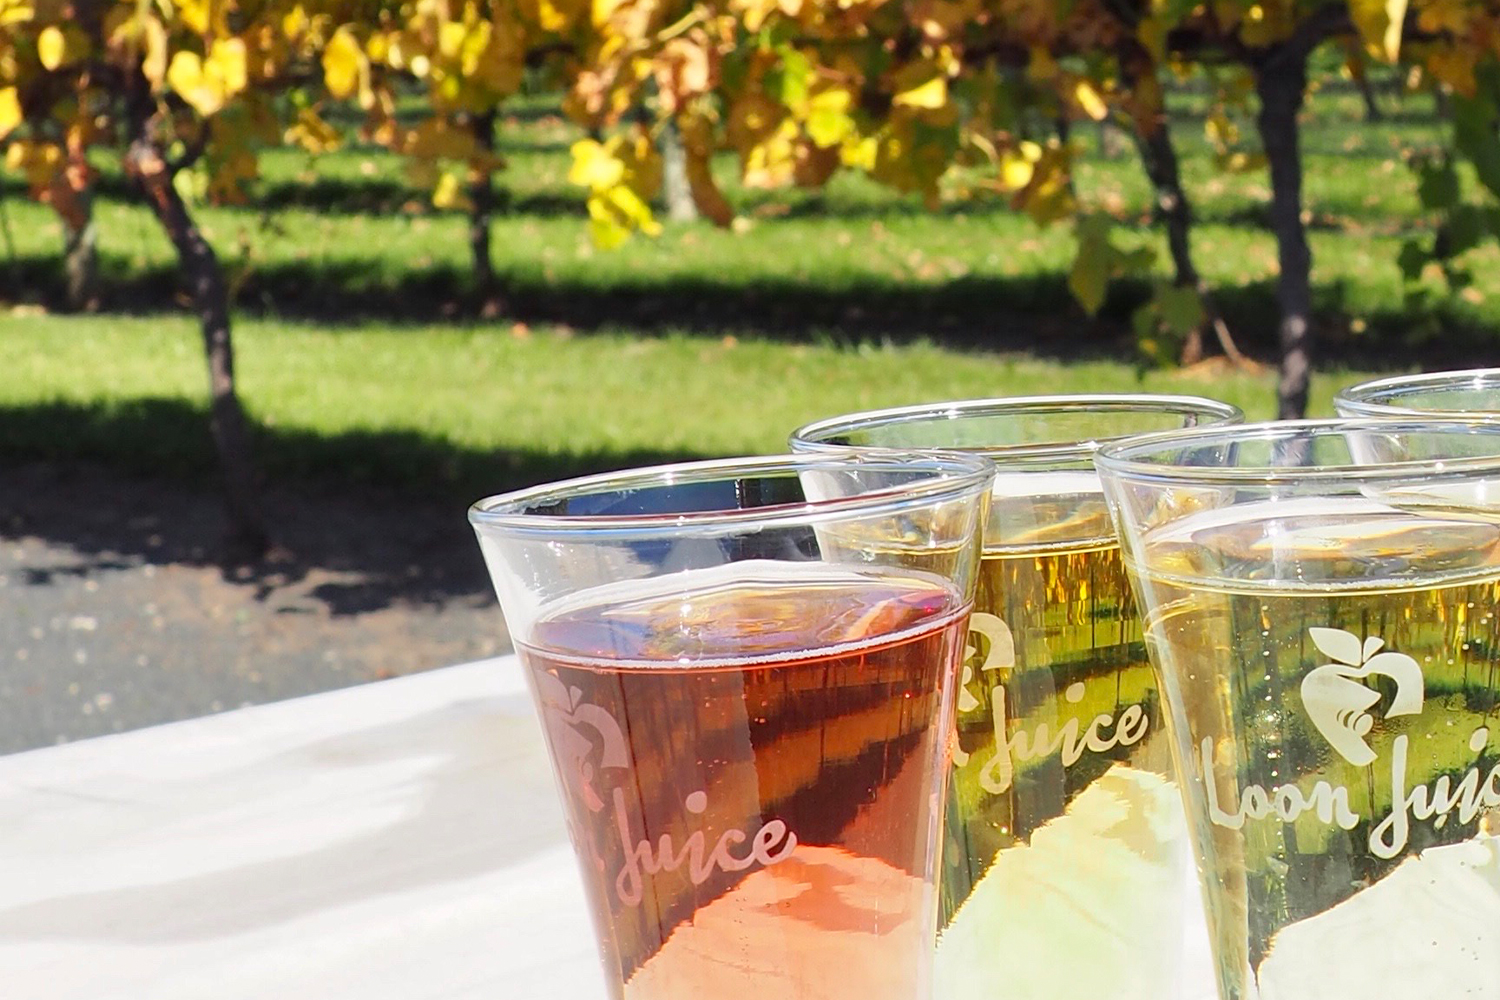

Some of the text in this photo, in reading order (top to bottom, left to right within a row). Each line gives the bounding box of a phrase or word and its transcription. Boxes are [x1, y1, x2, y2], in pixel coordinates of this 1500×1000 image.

[980, 682, 1149, 795] Juice
[1201, 735, 1360, 830] Loon
[613, 787, 798, 906] Juice
